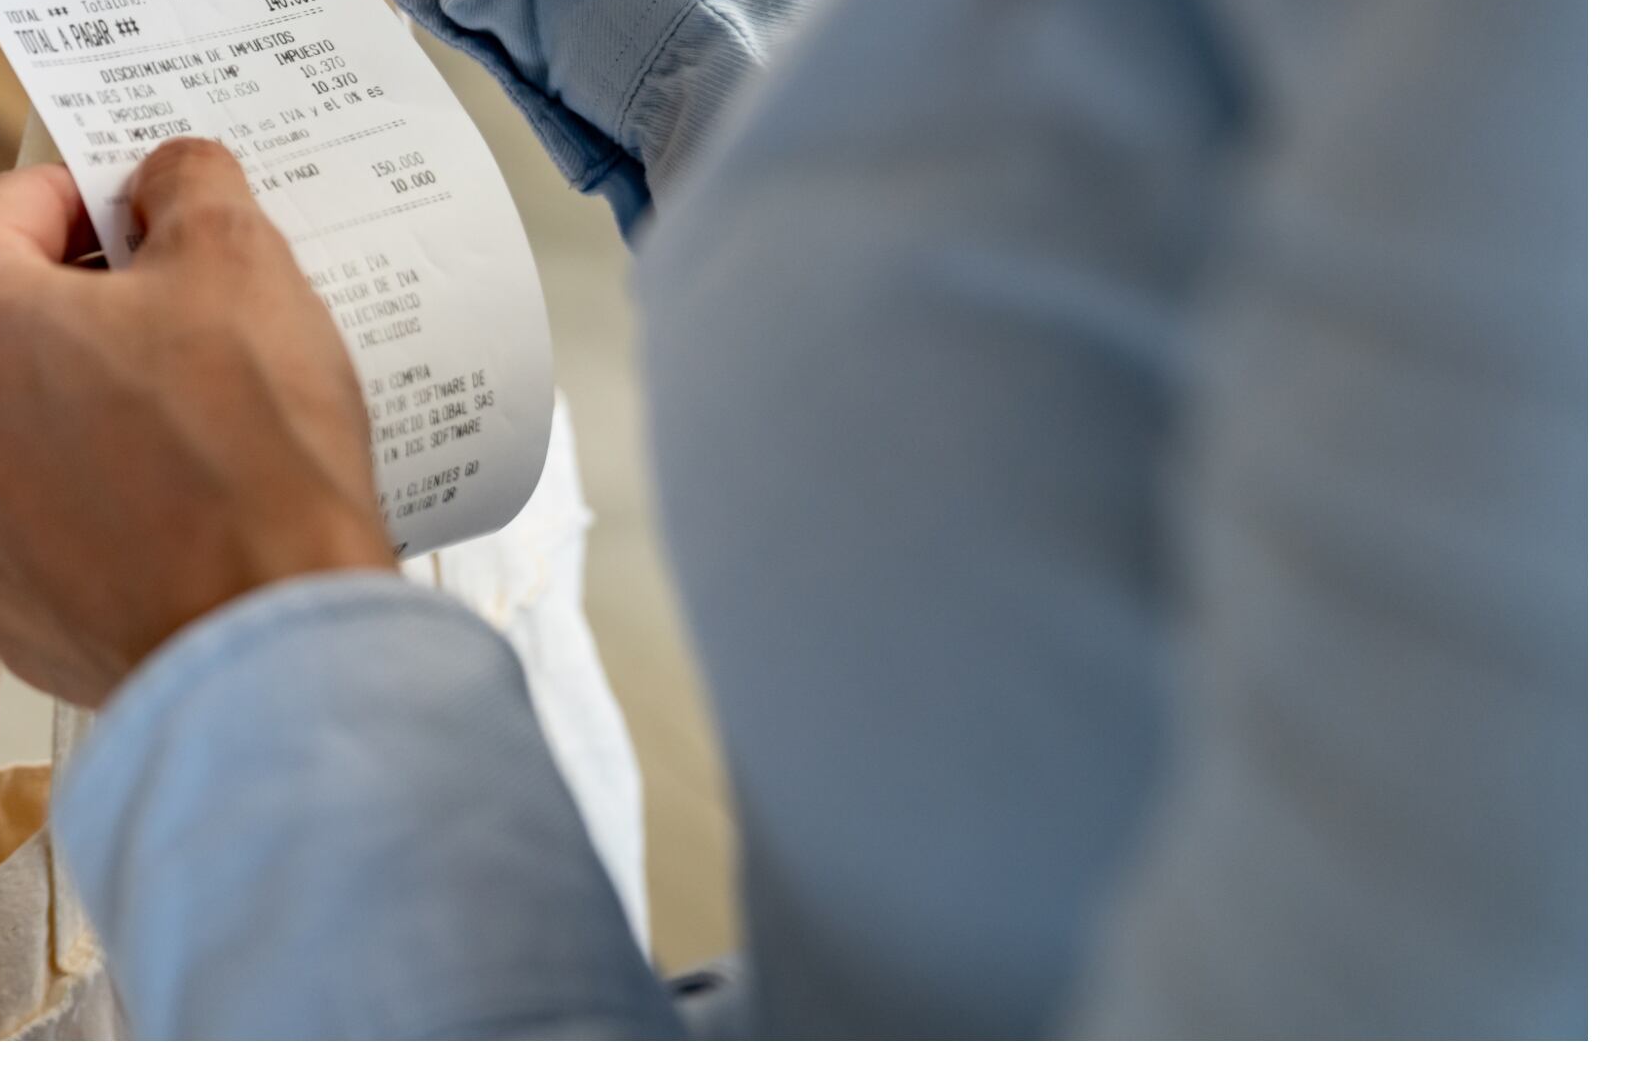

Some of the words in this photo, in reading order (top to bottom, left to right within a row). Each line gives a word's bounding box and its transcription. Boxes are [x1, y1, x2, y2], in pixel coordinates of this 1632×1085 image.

[4, 7, 42, 24] TOTAL
[13, 27, 60, 55] TOTAL
[57, 25, 73, 51] A
[69, 18, 116, 50] PAGAR
[100, 51, 203, 86] DISCRIMINACION
[207, 45, 225, 63] DE
[227, 29, 297, 59] IMPUESTOS
[124, 83, 158, 102] TASA
[180, 63, 243, 92] BASE/IMP
[274, 38, 336, 67] IMPUESTO
[299, 55, 348, 81] 10.370
[85, 127, 122, 148] TOTAL
[123, 117, 194, 144] IMPUESTOS
[310, 71, 360, 96] 10.370
[258, 117, 277, 131] es
[279, 105, 307, 124] IVA
[309, 103, 319, 118] y
[323, 95, 342, 112] el
[366, 84, 385, 100] es
[370, 150, 426, 179] 150.000
[389, 169, 438, 196] 10.000
[396, 268, 420, 289] IVA
[340, 292, 422, 329] ELECTRONICO
[413, 375, 466, 407] SOFTWARE
[471, 369, 486, 388] DE
[428, 400, 468, 427] GLOBAL
[473, 389, 494, 411] SAS
[430, 416, 482, 448] SOFTWARE
[406, 465, 461, 498] CLIENTES
